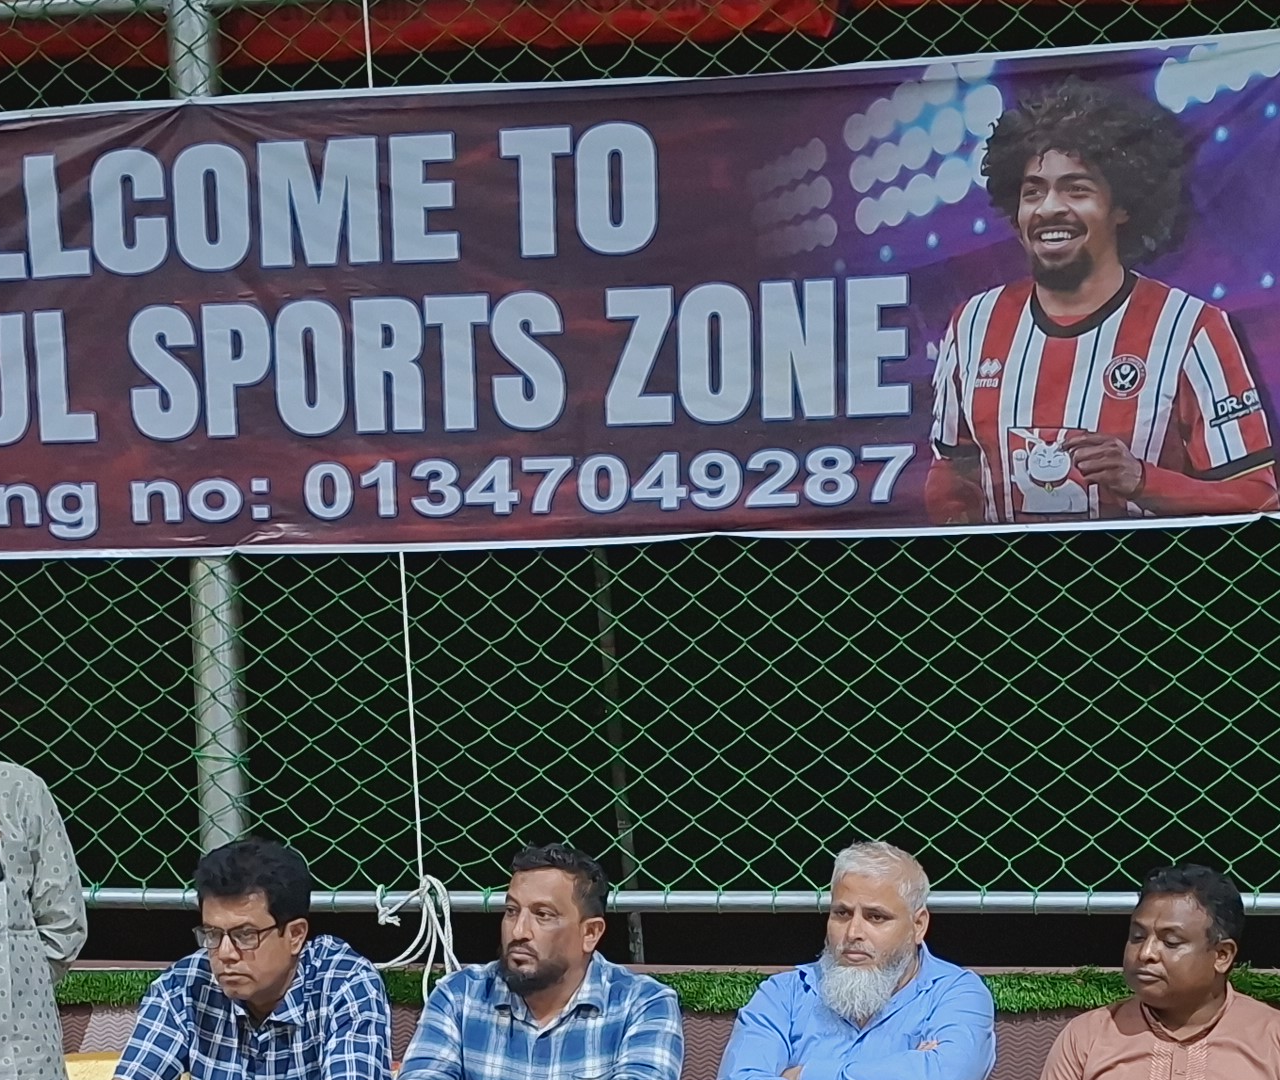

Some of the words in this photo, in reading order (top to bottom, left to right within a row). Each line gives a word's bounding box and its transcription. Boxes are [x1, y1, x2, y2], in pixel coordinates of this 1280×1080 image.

[499, 122, 657, 257] TO
[129, 291, 564, 439] SPORTS
[606, 275, 911, 426] ZONE
[131, 476, 272, 523] no:
[304, 444, 914, 519] 01347049287
